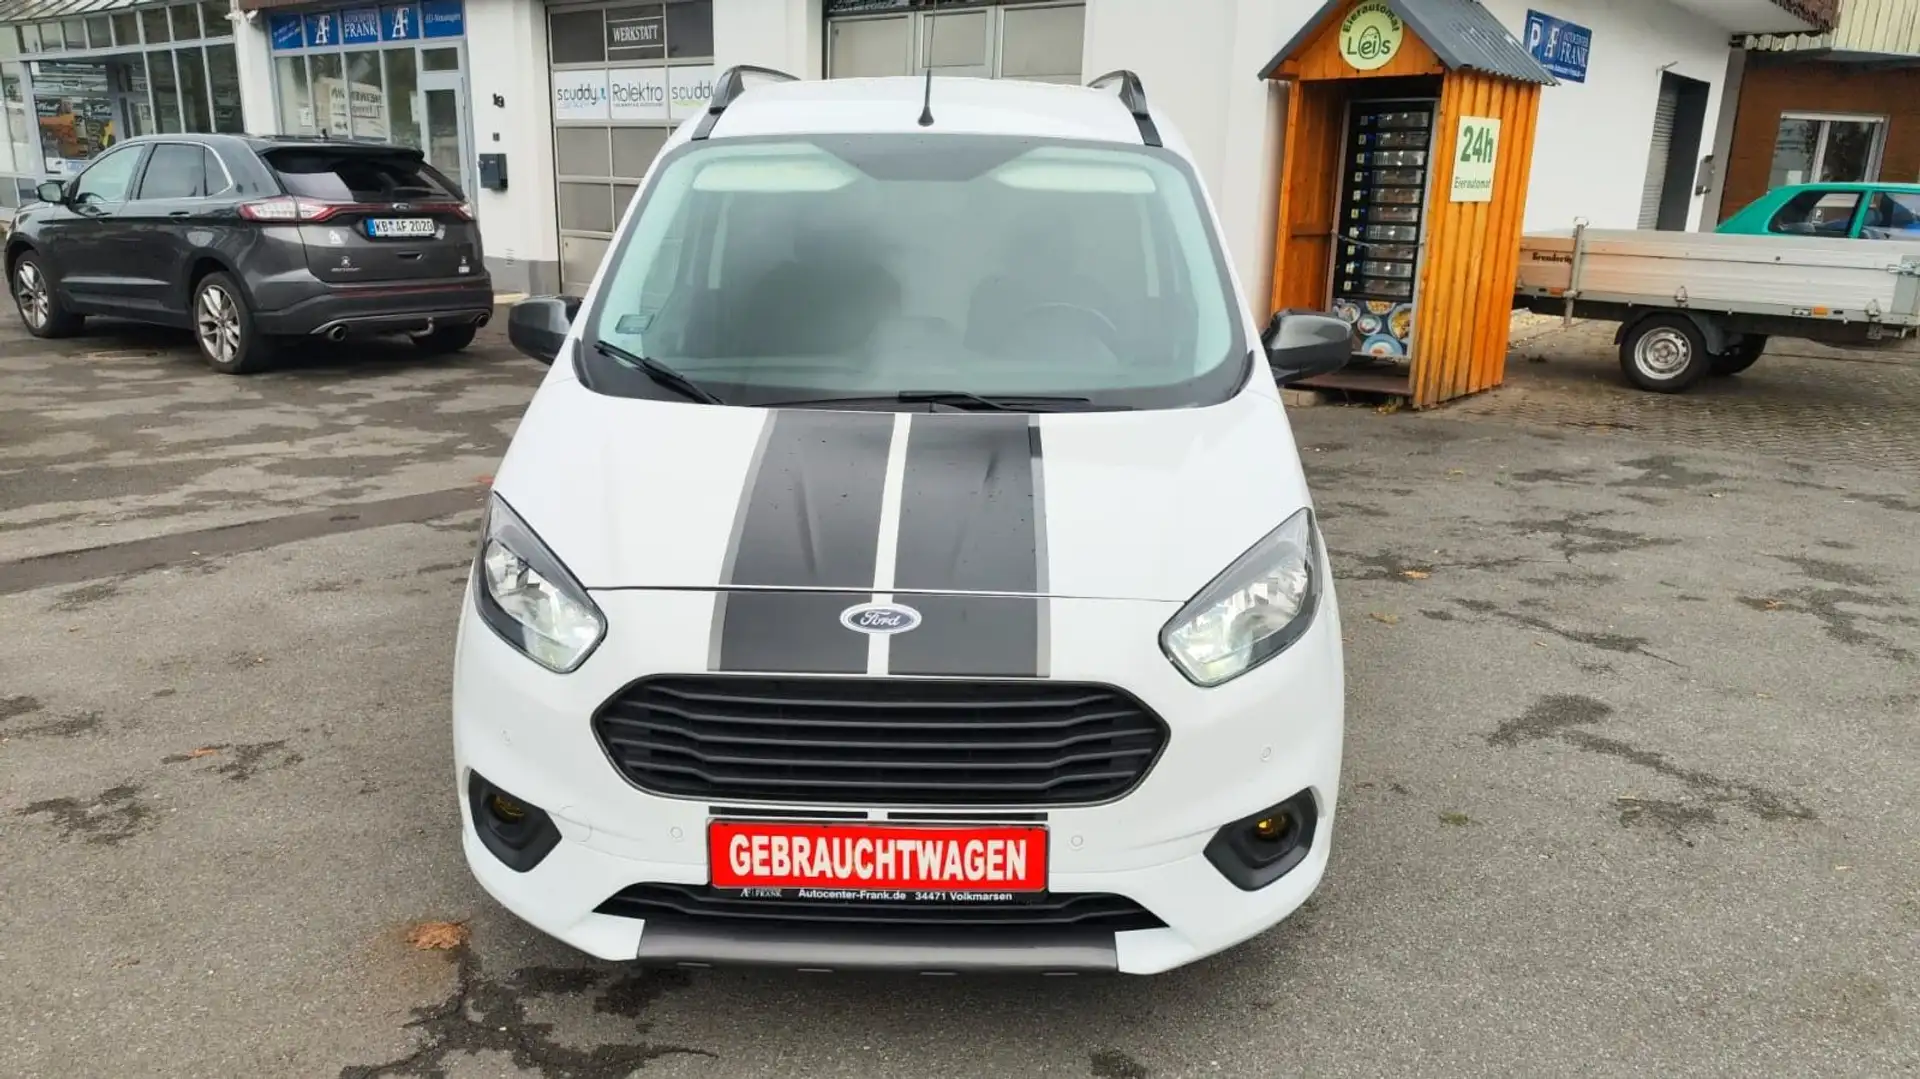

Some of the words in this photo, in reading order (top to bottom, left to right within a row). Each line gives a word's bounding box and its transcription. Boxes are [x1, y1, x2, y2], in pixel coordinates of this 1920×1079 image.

[1343, 4, 1400, 32] Eierautomat
[344, 22, 378, 38] FRANK
[612, 24, 659, 42] WERKSTATT
[1529, 22, 1541, 54] P
[1560, 41, 1588, 68] FRANK
[557, 82, 597, 105] scuddy
[612, 80, 663, 102] Rolektro
[1460, 125, 1494, 163] 24h
[374, 220, 389, 232] KB
[410, 221, 434, 232] 2020
[860, 611, 901, 626] Ford
[729, 834, 1027, 881] GEBRAUCHTWAGEN
[798, 888, 907, 900] Autocenter-Frank.de
[915, 891, 946, 900] 34471
[950, 891, 1013, 901] Volkmarsen
